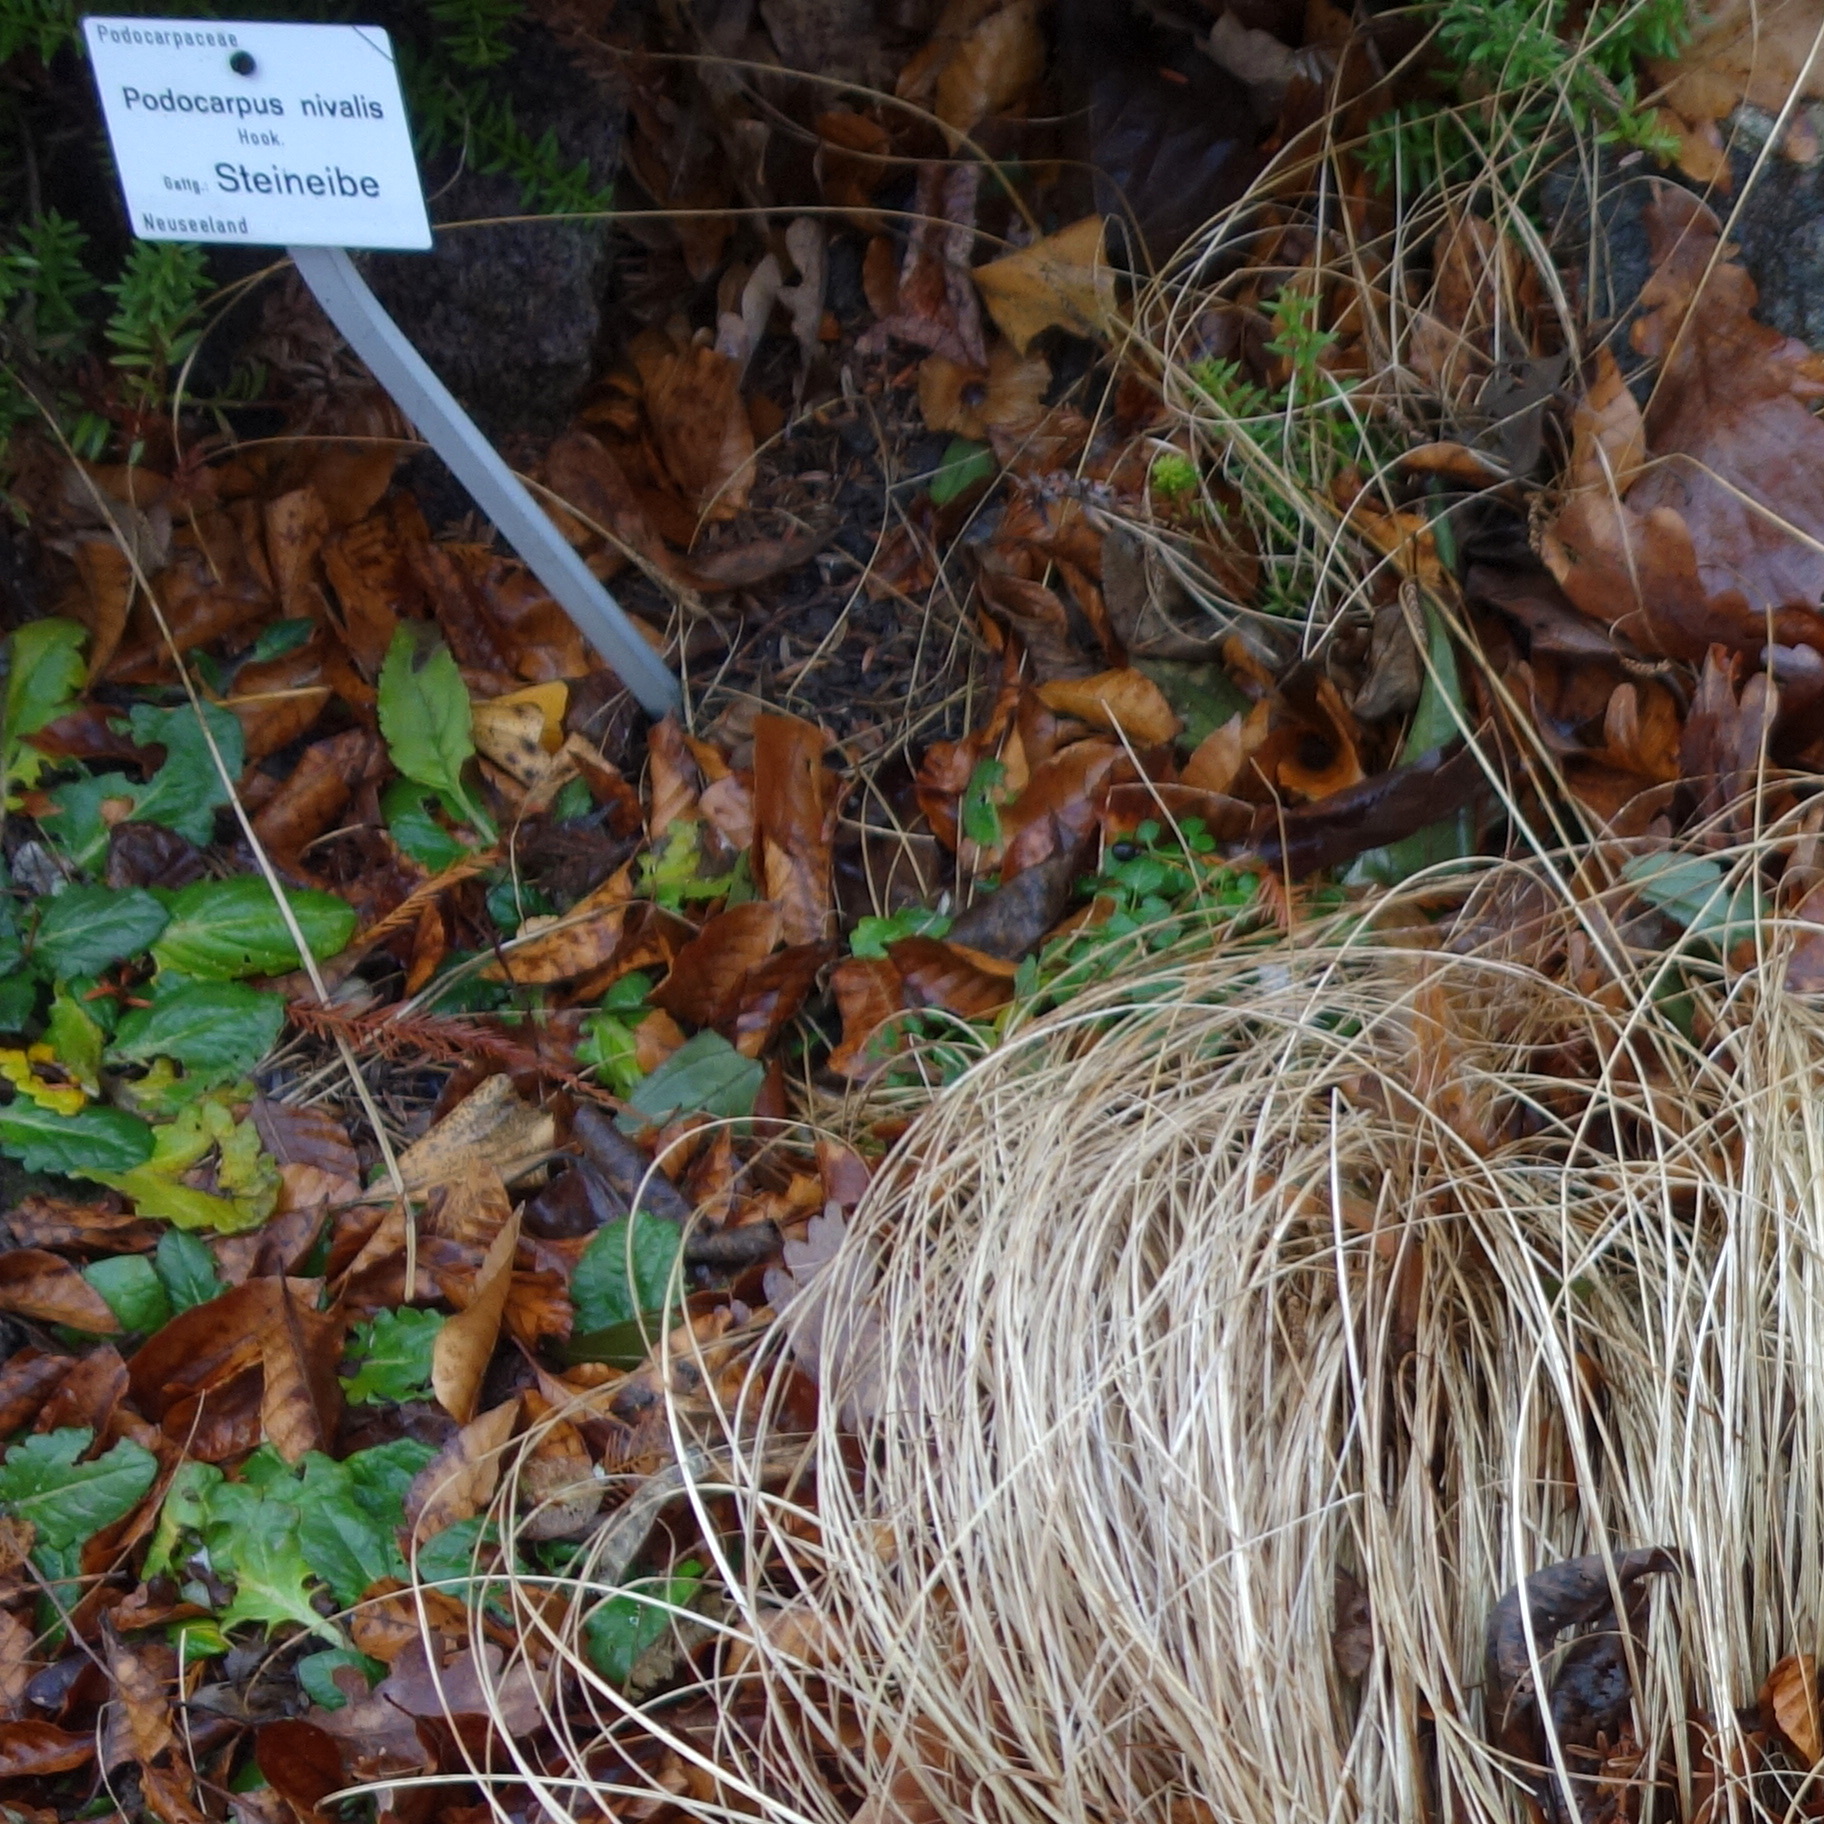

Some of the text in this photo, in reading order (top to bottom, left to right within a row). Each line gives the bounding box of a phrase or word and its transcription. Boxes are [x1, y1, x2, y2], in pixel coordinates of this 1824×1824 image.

[97, 25, 239, 49] Podocarpaceae
[122, 86, 384, 120] Podocarpus nivalis
[238, 129, 285, 147] Hook.
[214, 163, 380, 198] Steineibe
[142, 213, 249, 235] Neuseeland
